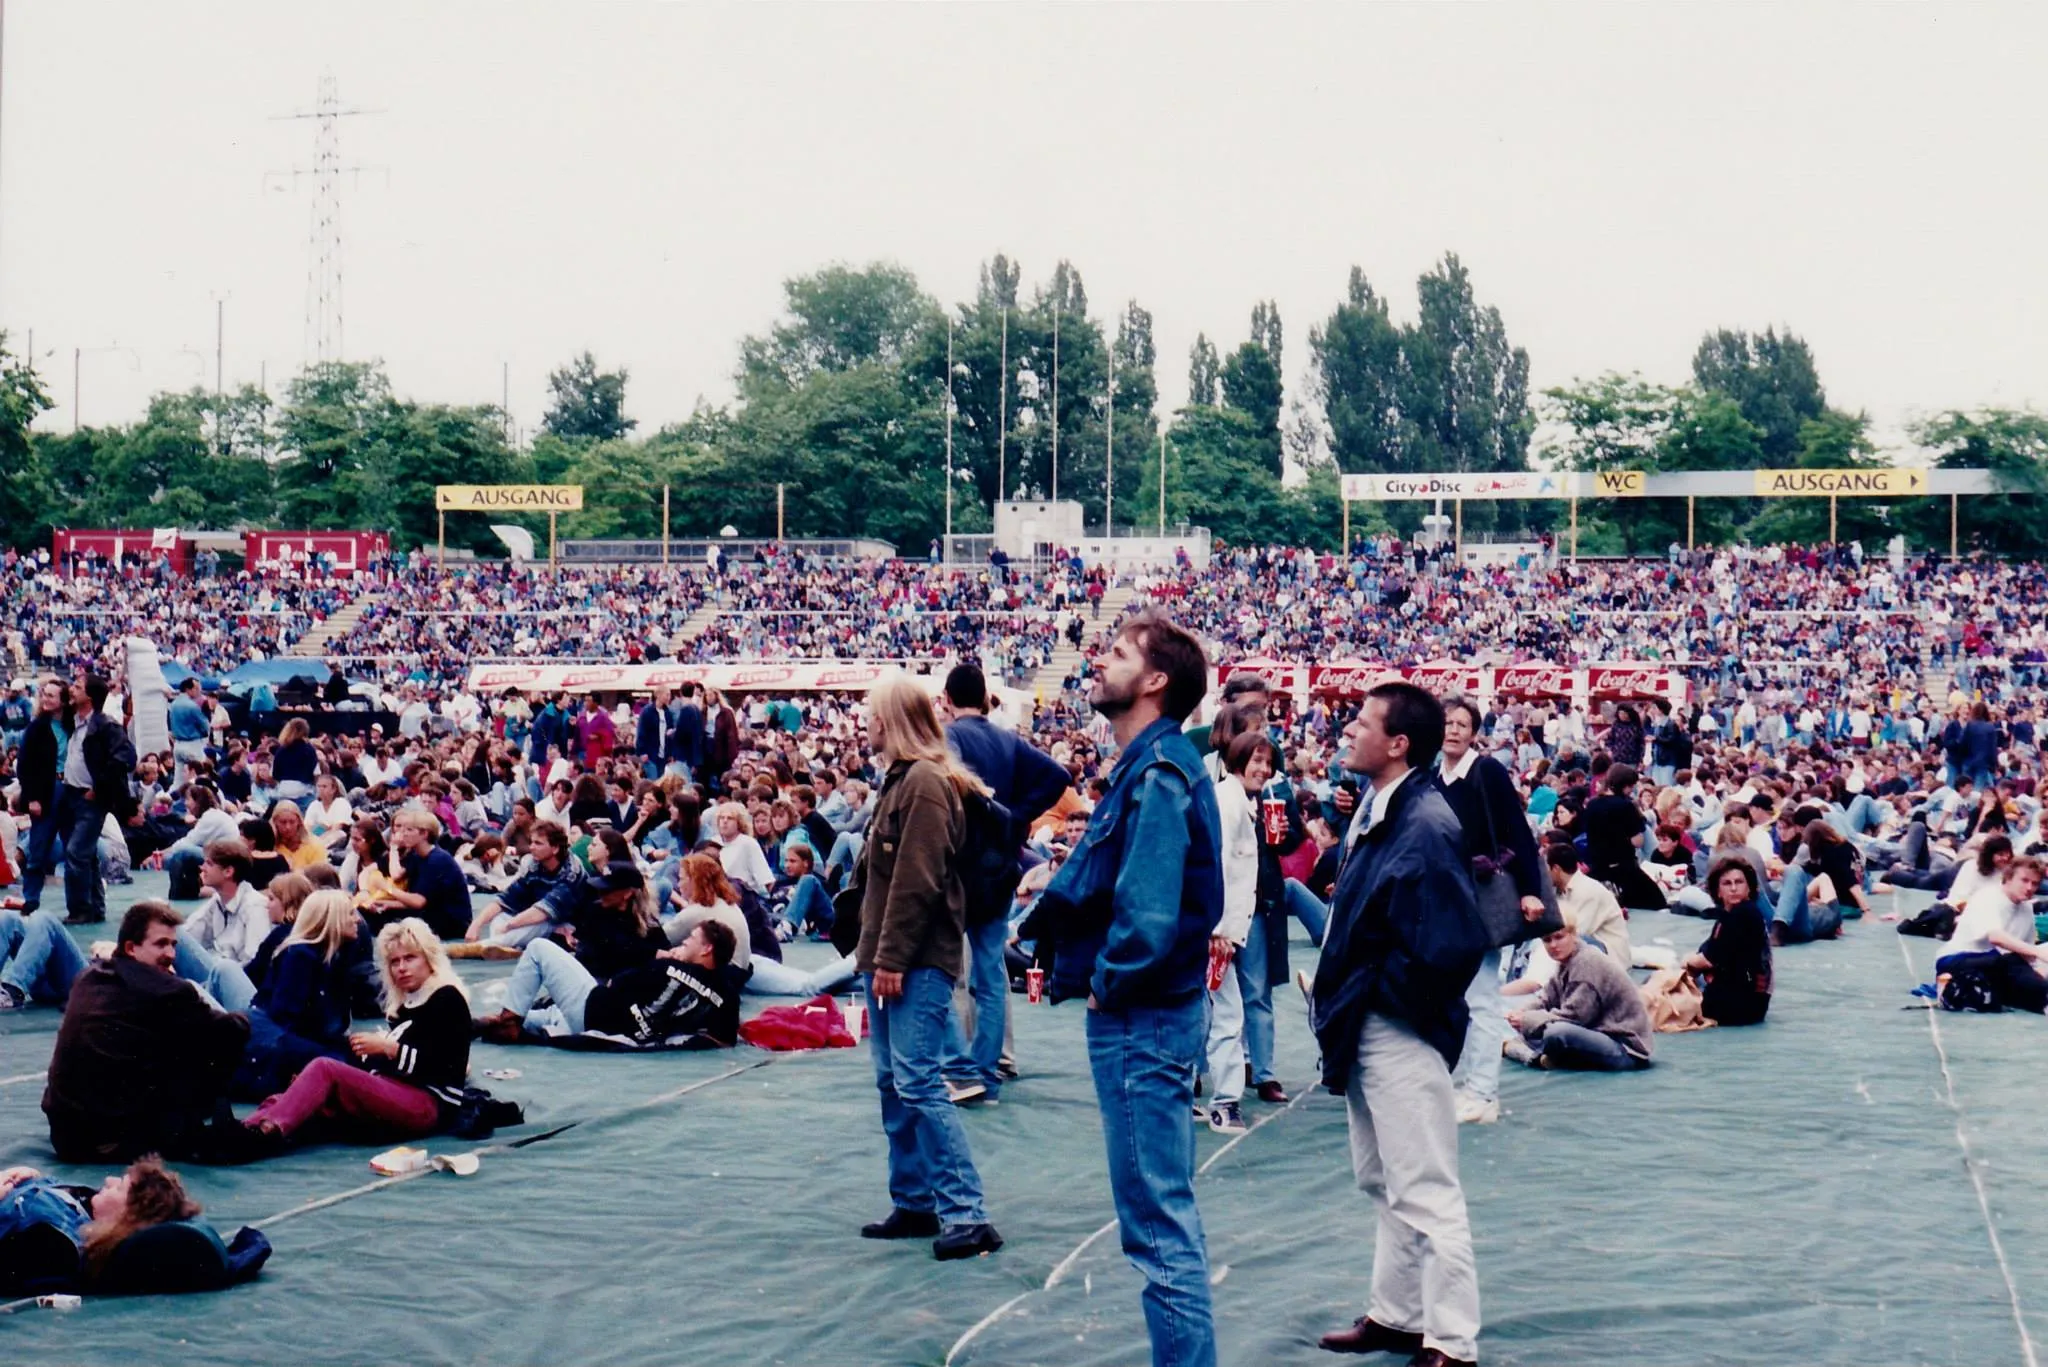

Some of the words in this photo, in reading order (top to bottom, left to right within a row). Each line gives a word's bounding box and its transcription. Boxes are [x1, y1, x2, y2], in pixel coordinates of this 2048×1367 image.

[1385, 479, 1417, 497] City
[1429, 479, 1461, 493] Disc
[1603, 473, 1638, 490] WC
[1772, 473, 1888, 490] AUSGANG
[471, 489, 571, 505] AUSGANG
